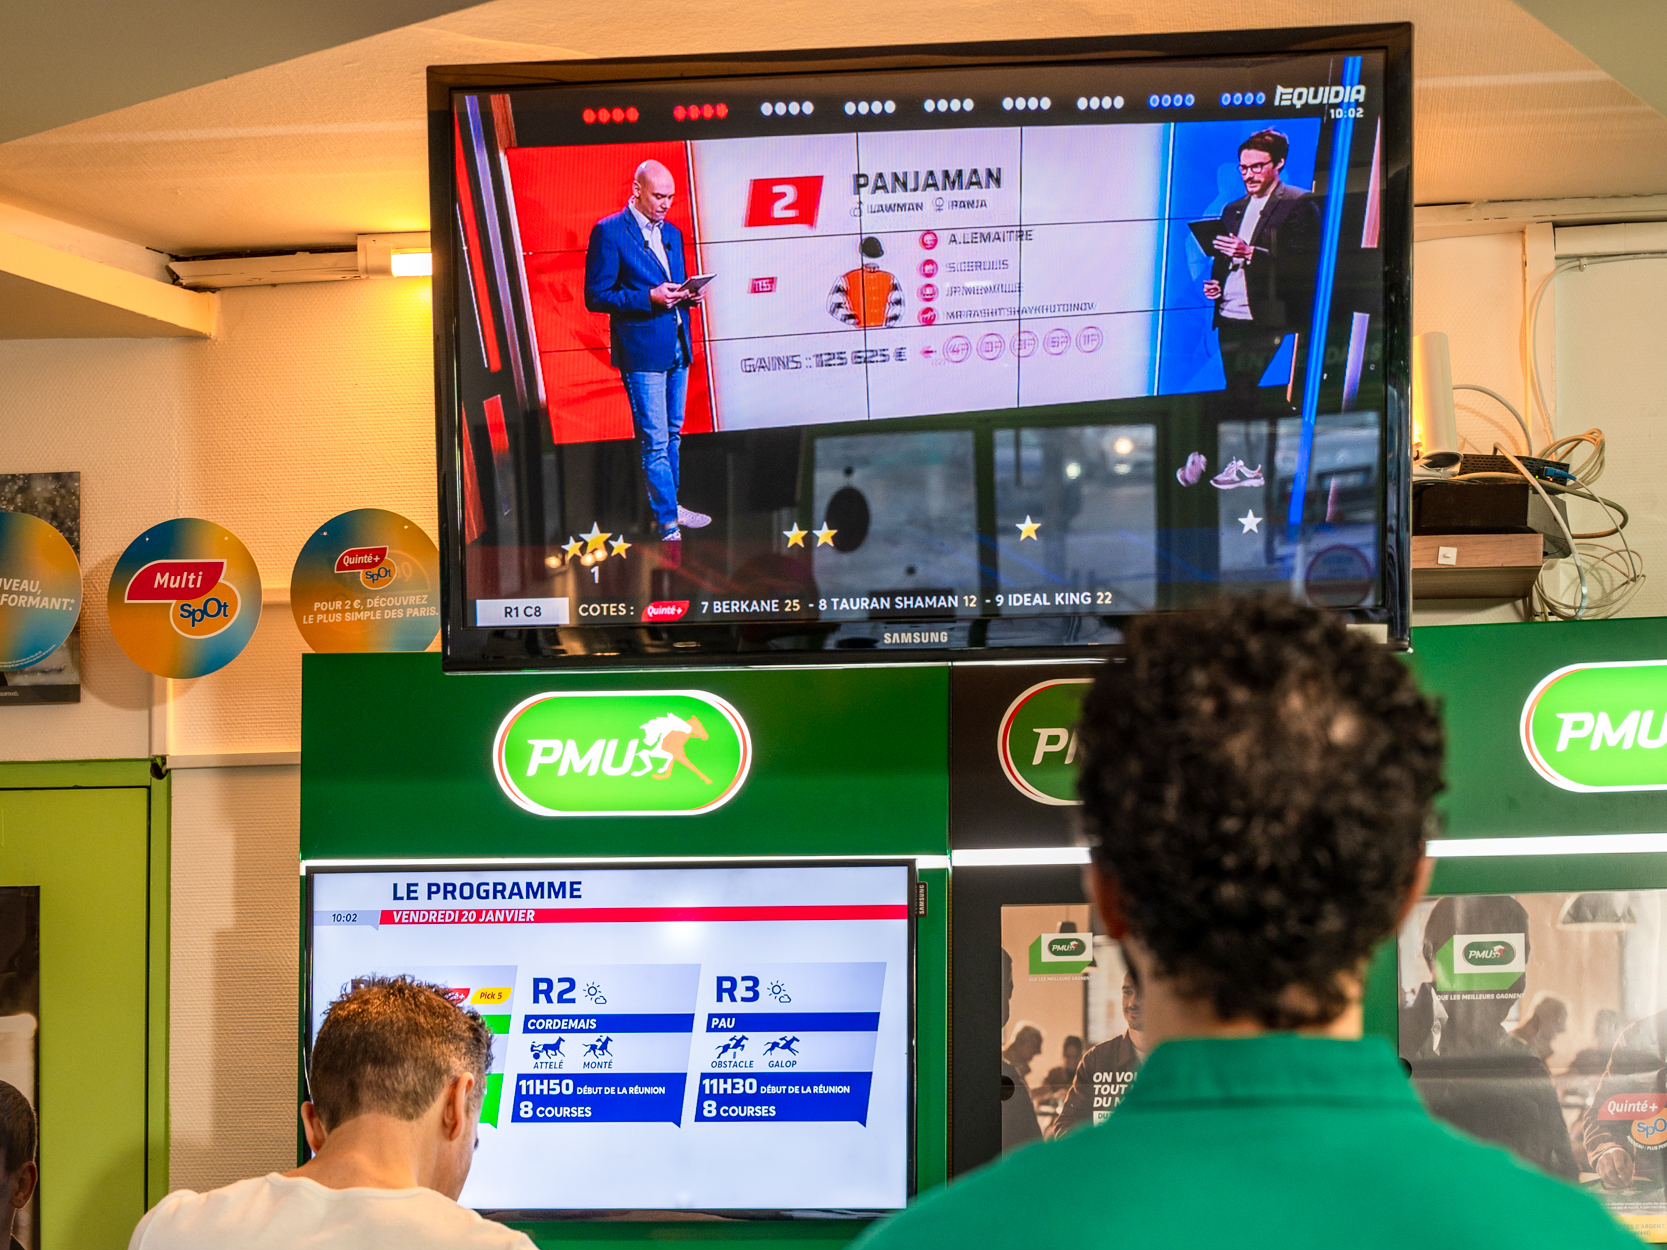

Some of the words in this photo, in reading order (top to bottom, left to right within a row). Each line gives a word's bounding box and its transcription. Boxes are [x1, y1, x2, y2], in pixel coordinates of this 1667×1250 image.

[1274, 84, 1366, 109] EQUIDIA
[1330, 107, 1364, 119] 10:02
[853, 167, 1002, 195] PANJAMAN
[771, 184, 799, 219] 2
[343, 554, 380, 567] Quinté+
[154, 571, 203, 589] Multi
[590, 565, 599, 584] 1
[314, 600, 342, 612] POUR
[344, 600, 351, 610] 2
[366, 594, 428, 608] DÉCOUVREZ
[701, 601, 709, 613] 7
[712, 600, 780, 613] BERKANE
[784, 599, 801, 612] 25
[818, 598, 827, 611] 8
[831, 596, 891, 611] TAURAN
[894, 595, 959, 610] SHAMAN
[963, 594, 978, 608] 12
[995, 594, 1004, 607] 9
[1008, 593, 1051, 607] IDEAL
[1055, 592, 1092, 605] KING
[1096, 591, 1113, 604] 22
[302, 614, 314, 625] LE
[316, 613, 342, 624] PLUS
[344, 611, 382, 622] SIMPLE
[384, 608, 404, 619] DES
[406, 606, 439, 618] PARIS.
[504, 606, 519, 618] R1
[523, 605, 542, 618] C8
[578, 603, 627, 617] COTES
[647, 605, 683, 617] Quinté+
[884, 631, 949, 645] SAMSUNG
[526, 738, 639, 777] PMU
[392, 882, 419, 901] LE
[427, 880, 582, 901] PROGRAMME
[331, 913, 358, 923] 10:02
[393, 910, 459, 923] VENDREDI
[460, 910, 477, 923] 20
[478, 910, 535, 923] JANVIER
[1052, 944, 1069, 952] PMU
[1468, 949, 1493, 959] PMU
[480, 991, 496, 1000] Pick
[497, 992, 503, 1000] 5
[532, 977, 576, 1004] R2
[715, 975, 760, 1003] R3
[527, 1019, 597, 1030] CORDEMAIS
[711, 1018, 735, 1029] PAU
[533, 1059, 564, 1069] ATTELÉ
[583, 1059, 613, 1069] MONTÉ
[711, 1060, 754, 1069] OBSTACLE
[768, 1060, 797, 1068] GALOP
[1092, 1071, 1113, 1083] ON
[519, 1079, 574, 1095] 11H50
[576, 1085, 602, 1095] DÉBUT
[604, 1086, 616, 1095] DE
[617, 1086, 628, 1095] LA
[629, 1085, 666, 1095] RÉUNION
[702, 1078, 757, 1094] 11H30
[760, 1084, 787, 1094] DÉBUT
[788, 1086, 800, 1094] DE
[801, 1085, 812, 1094] LA
[813, 1084, 850, 1094] RÉUNION
[1093, 1084, 1128, 1095] TOUT
[703, 1100, 717, 1117] 8
[720, 1106, 776, 1117] COURSES
[1093, 1096, 1112, 1108] DU
[1607, 1099, 1658, 1116] Quinté+
[519, 1101, 533, 1118] 8
[536, 1106, 592, 1117] COURSES
